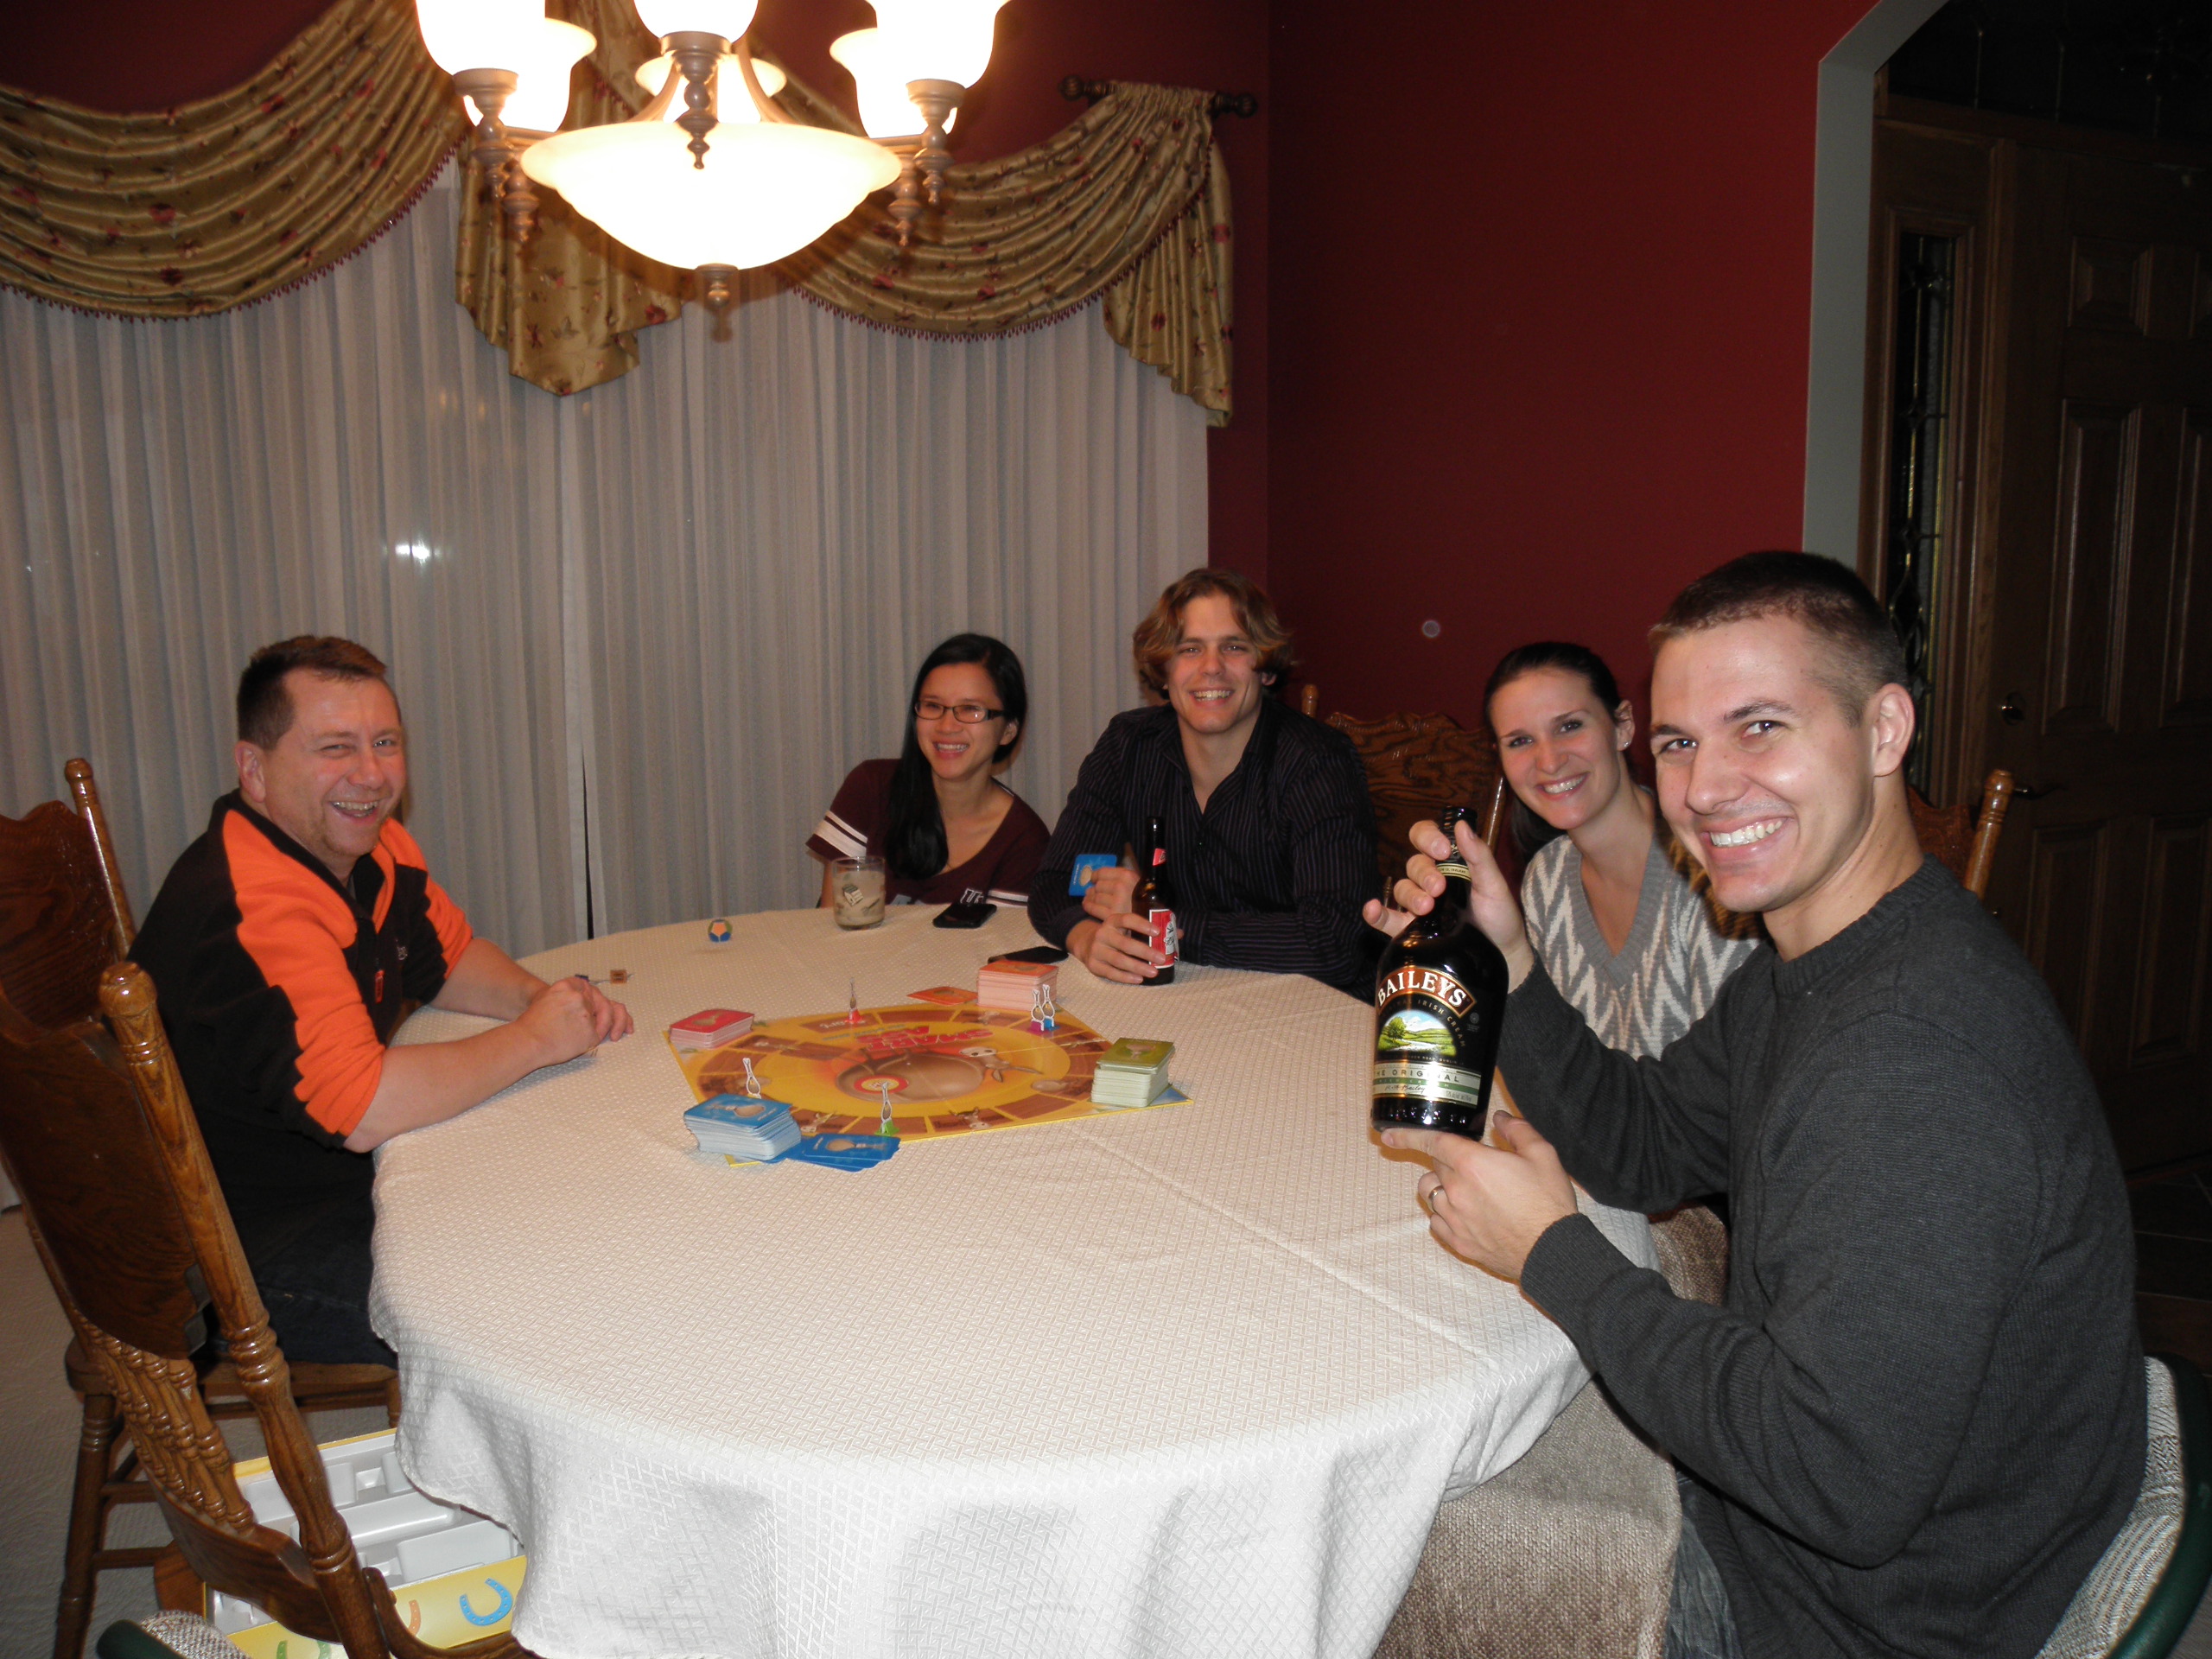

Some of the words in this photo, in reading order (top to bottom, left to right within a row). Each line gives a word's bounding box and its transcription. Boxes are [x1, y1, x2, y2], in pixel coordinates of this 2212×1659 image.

[1377, 970, 1467, 1007] BAILEYS
[1417, 999, 1445, 1014] IRISH
[1446, 1016, 1466, 1046] CREAM
[1392, 1069, 1459, 1083] ORIGAL
